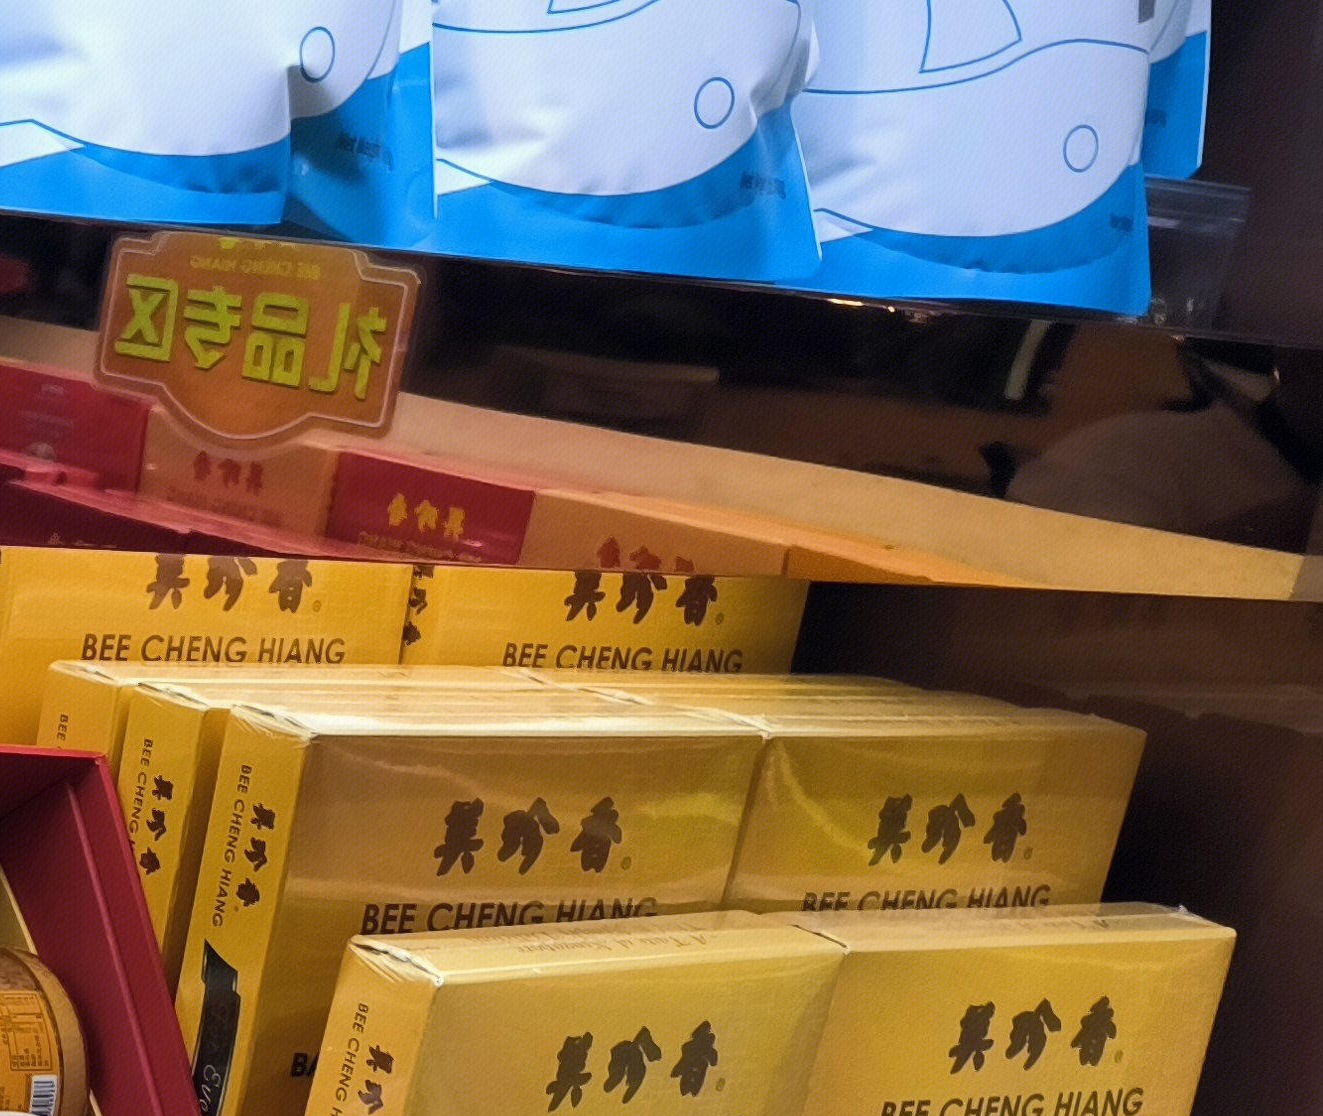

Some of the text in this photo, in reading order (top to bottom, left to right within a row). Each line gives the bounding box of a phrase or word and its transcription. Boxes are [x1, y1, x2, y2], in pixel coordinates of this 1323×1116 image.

[81, 633, 345, 665] BEE CHENG HIANG
[502, 642, 743, 673] BEE CHENG HIANG
[128, 738, 153, 834] BEE CHENG
[212, 765, 252, 927] BEE CHENG HIANG
[433, 796, 623, 877] 美珍香
[867, 792, 1028, 867] 美珍香
[361, 903, 415, 935] BEE
[427, 899, 544, 931] CHENG
[352, 1002, 369, 1035] BEE
[948, 996, 1117, 1075] 美珍香
[332, 1037, 361, 1102] CHENG
[545, 1020, 719, 1112] 美珍香
